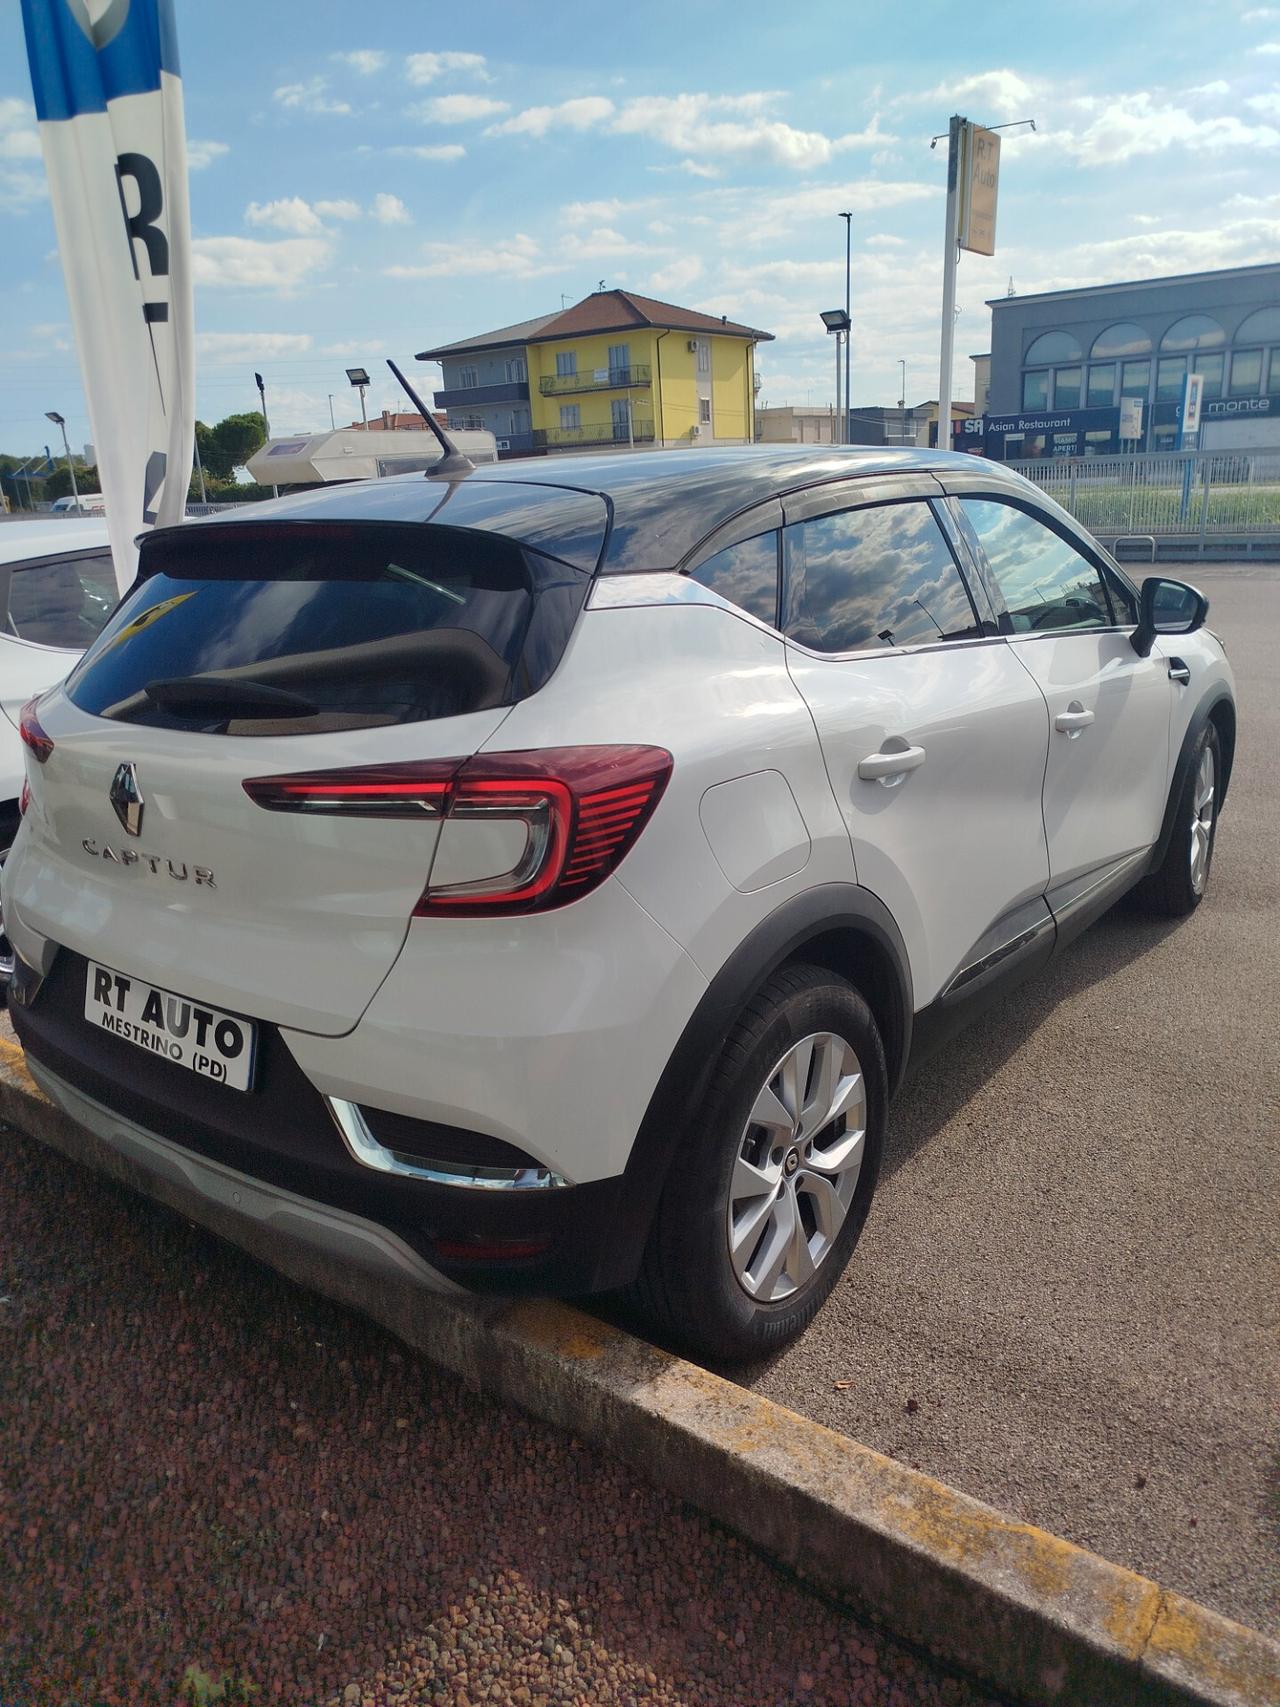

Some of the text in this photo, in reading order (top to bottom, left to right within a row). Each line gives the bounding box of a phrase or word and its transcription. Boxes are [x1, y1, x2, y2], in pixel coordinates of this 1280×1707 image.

[988, 418, 1071, 432] Asian Restaurant
[1208, 399, 1270, 413] monte
[82, 838, 217, 888] CAPTUR
[94, 967, 244, 1059] RT AUTO
[101, 1012, 227, 1083] MESTRINO (PD)
